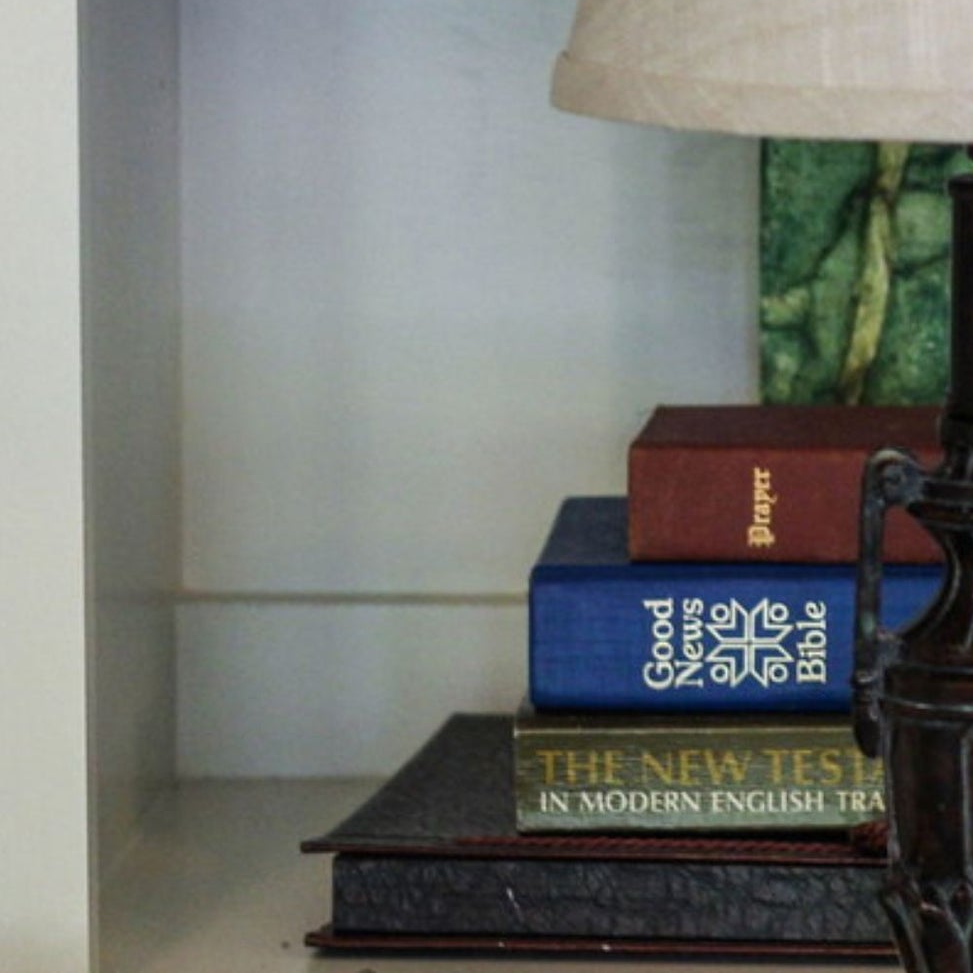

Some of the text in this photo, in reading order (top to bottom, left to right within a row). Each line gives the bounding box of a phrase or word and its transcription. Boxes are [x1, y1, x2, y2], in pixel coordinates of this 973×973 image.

[748, 467, 778, 548] Prayer
[643, 598, 674, 690] Good
[675, 598, 704, 687] News
[796, 601, 827, 684] Bible
[536, 748, 625, 786] THE
[641, 748, 752, 786] NEW
[540, 790, 886, 814] IN MODERN ENGLISH TRA
